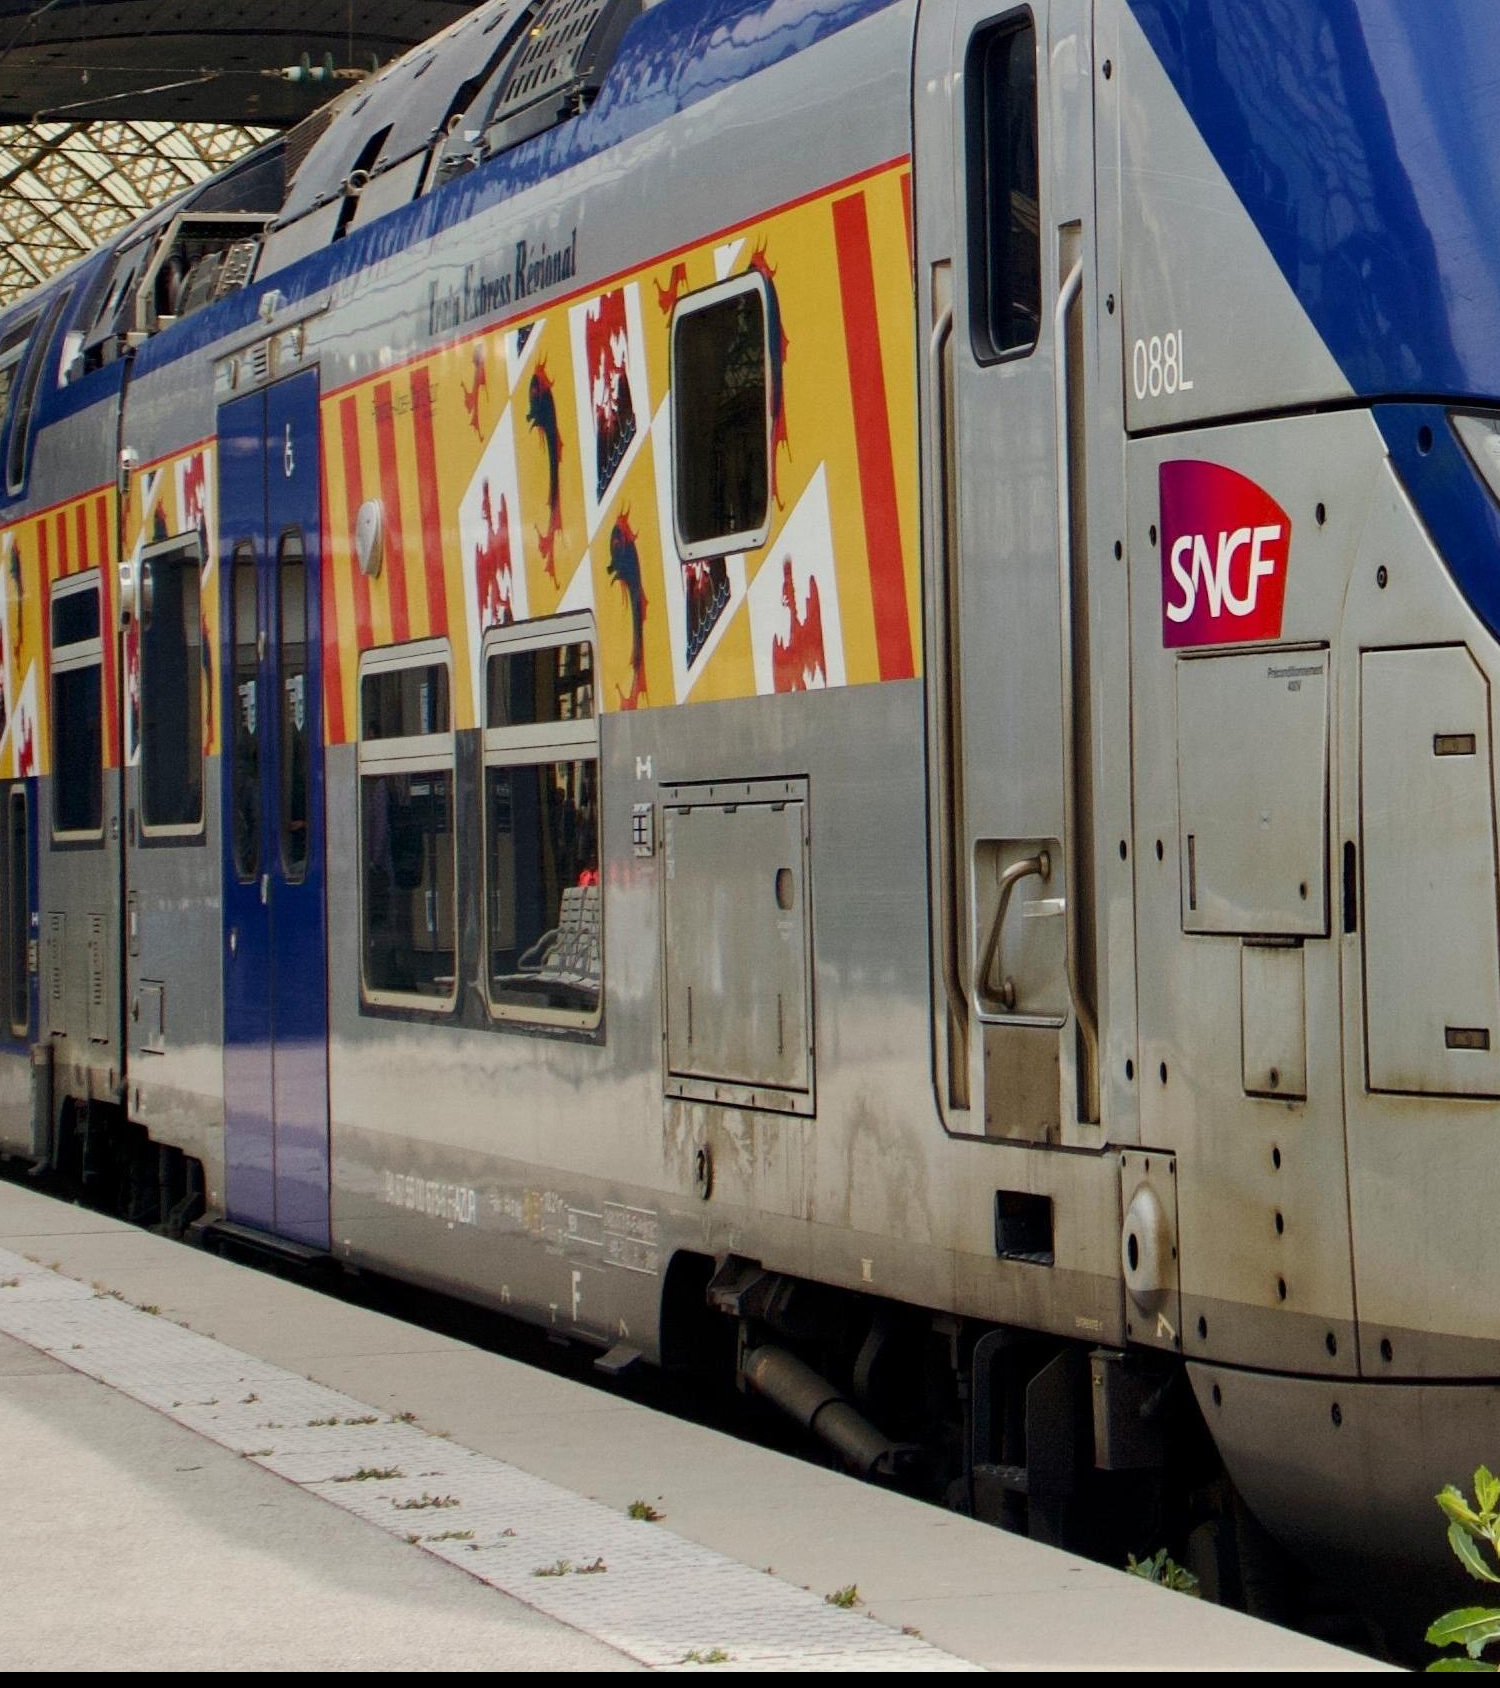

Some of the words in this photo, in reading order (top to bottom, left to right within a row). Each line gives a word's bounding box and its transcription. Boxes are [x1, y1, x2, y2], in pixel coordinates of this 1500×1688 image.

[514, 226, 577, 301] Régional
[1133, 329, 1194, 400] 088L
[1166, 525, 1281, 623] SNCF
